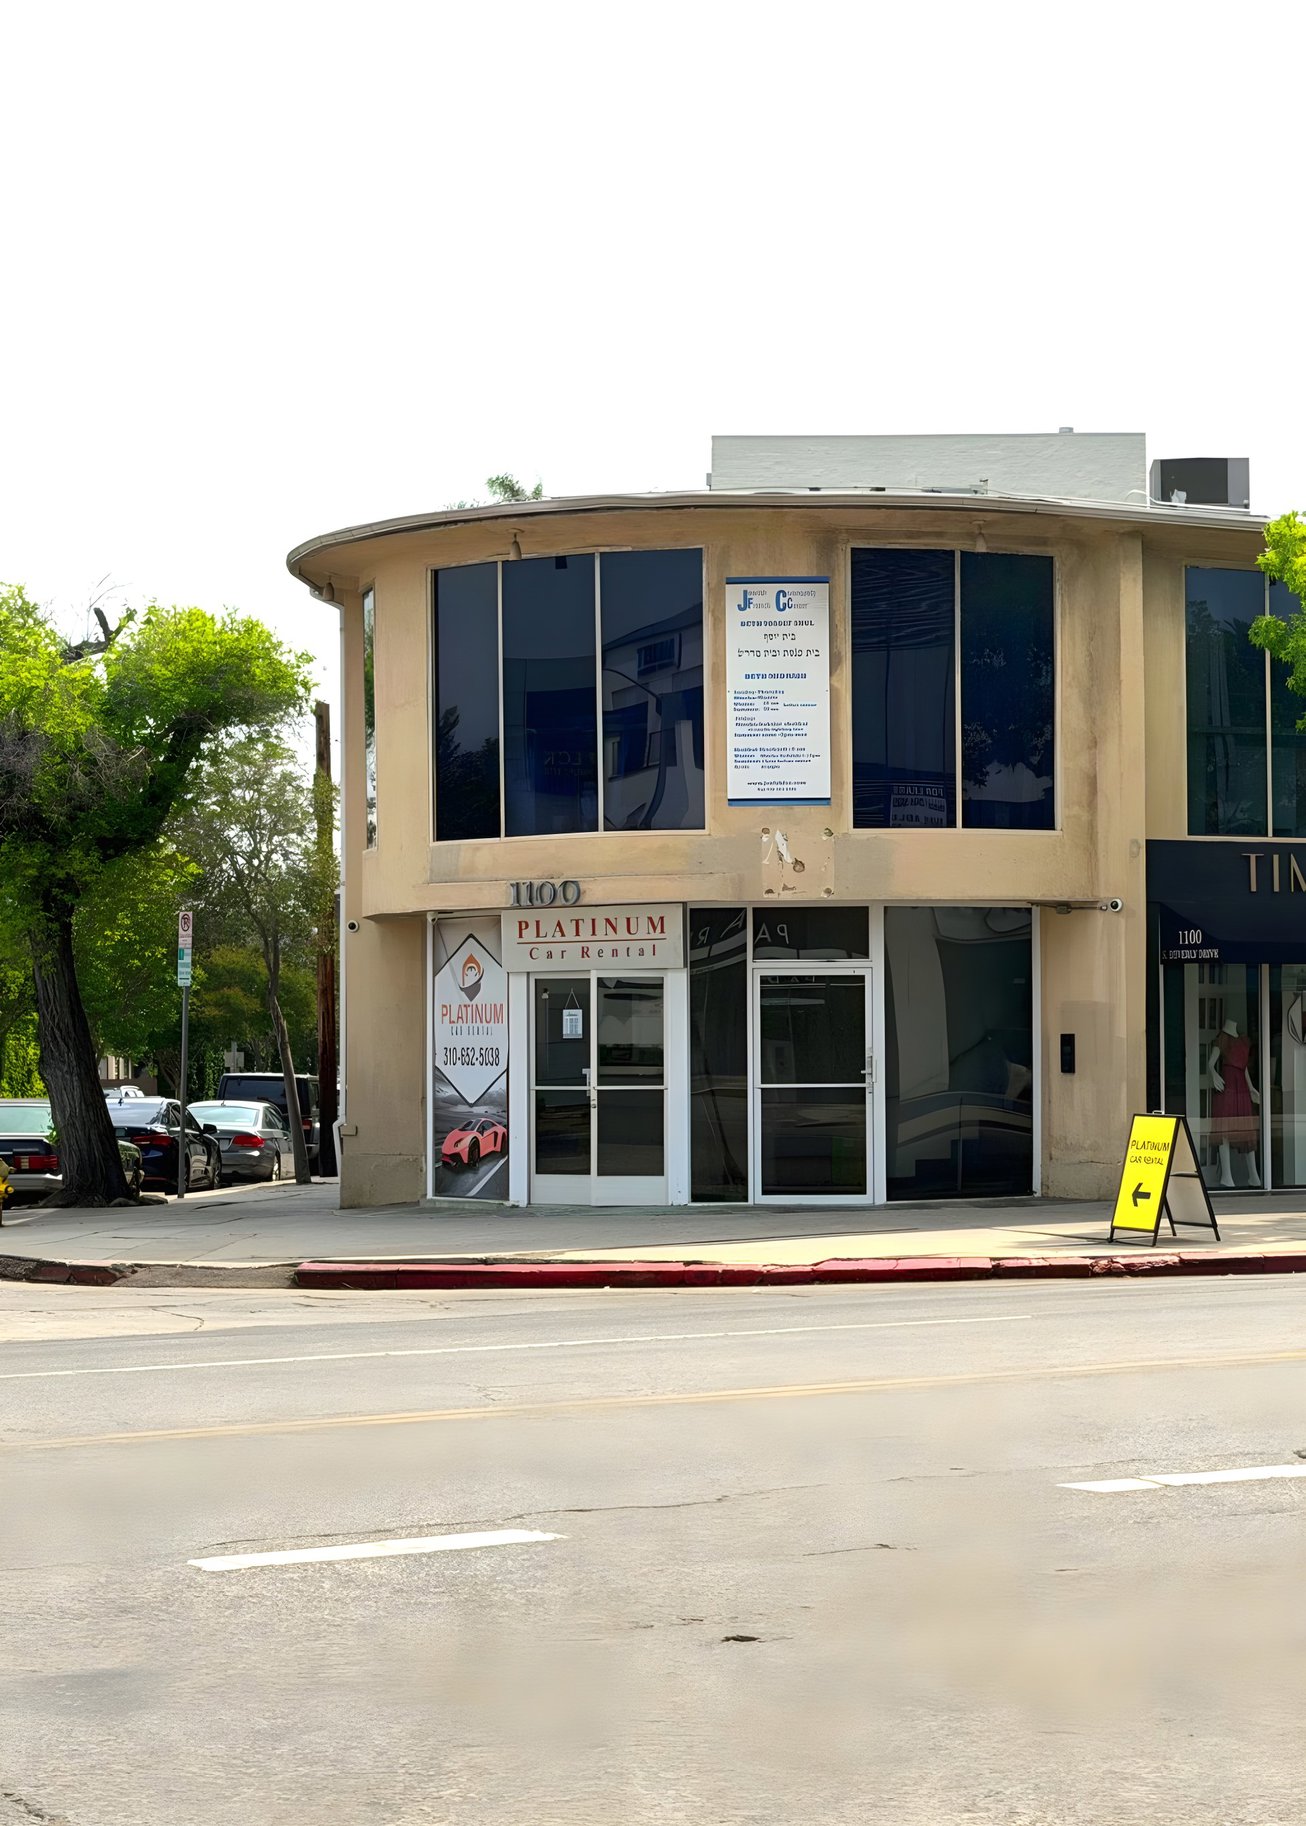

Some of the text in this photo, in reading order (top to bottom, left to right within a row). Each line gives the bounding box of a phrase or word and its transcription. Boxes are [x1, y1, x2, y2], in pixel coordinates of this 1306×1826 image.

[509, 880, 581, 907] 1100
[517, 915, 666, 939] PLATINUM
[1178, 929, 1202, 945] 1100
[529, 944, 656, 960] Car Rental
[441, 1003, 504, 1024] PLATINUM
